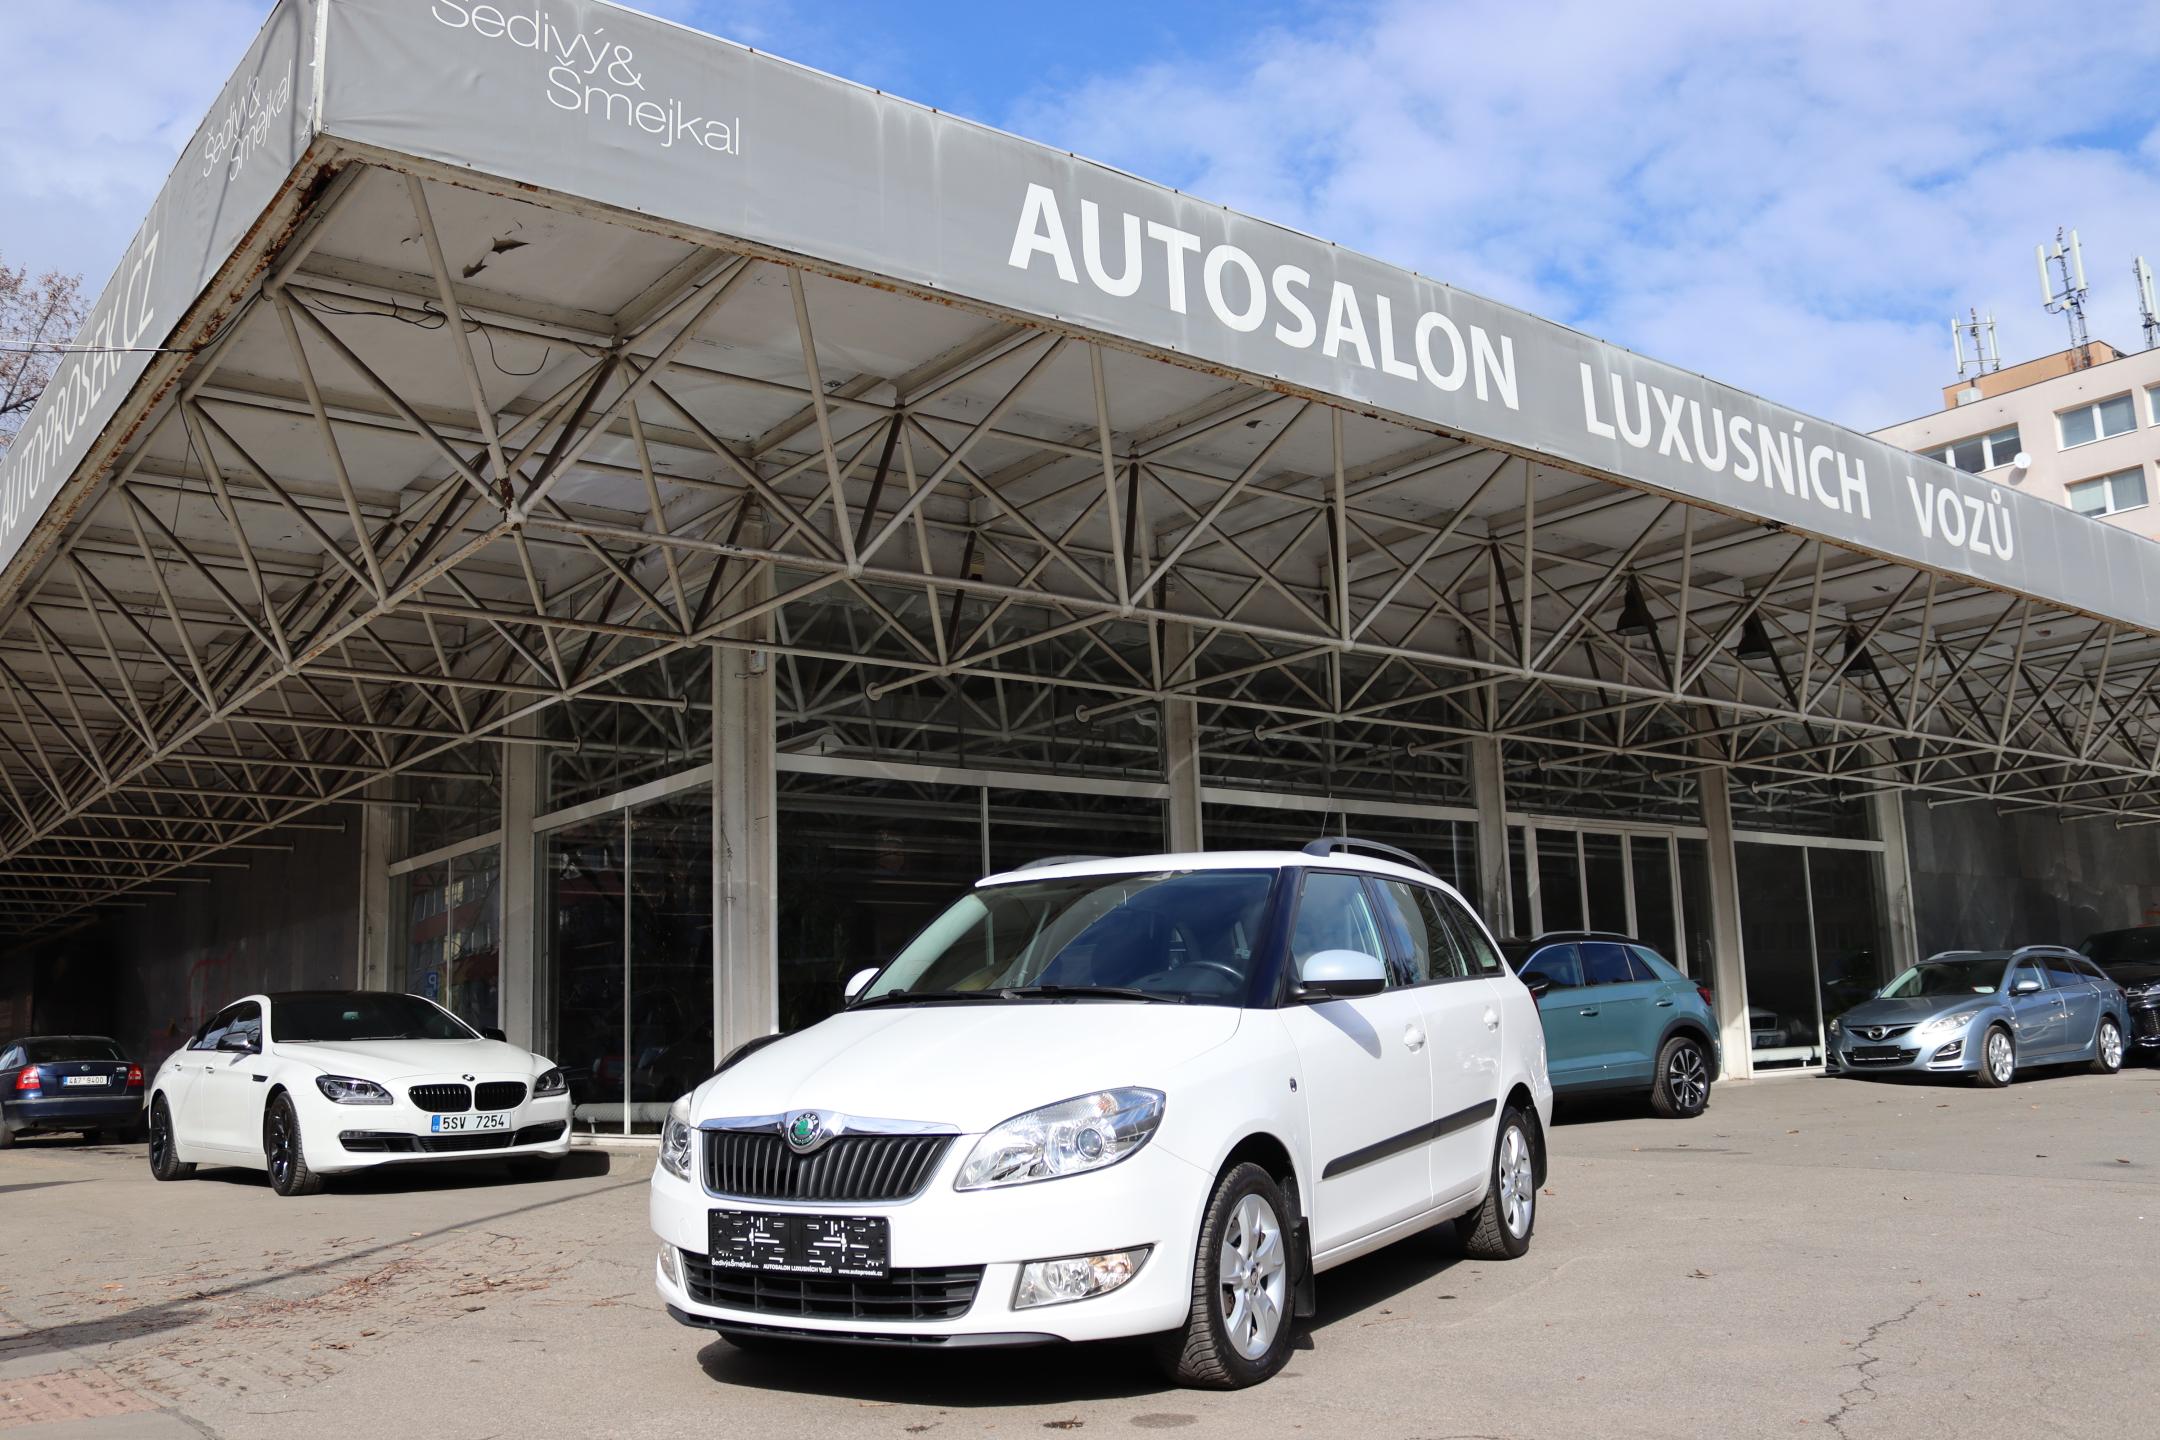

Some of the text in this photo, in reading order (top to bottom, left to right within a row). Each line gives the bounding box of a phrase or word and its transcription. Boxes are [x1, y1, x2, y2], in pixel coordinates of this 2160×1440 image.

[229, 59, 292, 181] Šmejkal
[546, 55, 741, 156] Šmejkal
[1008, 182, 2015, 561] AUTOSALON LUXUSNÍCH VOZŮ
[443, 1114, 505, 1130] 5SV 7254
